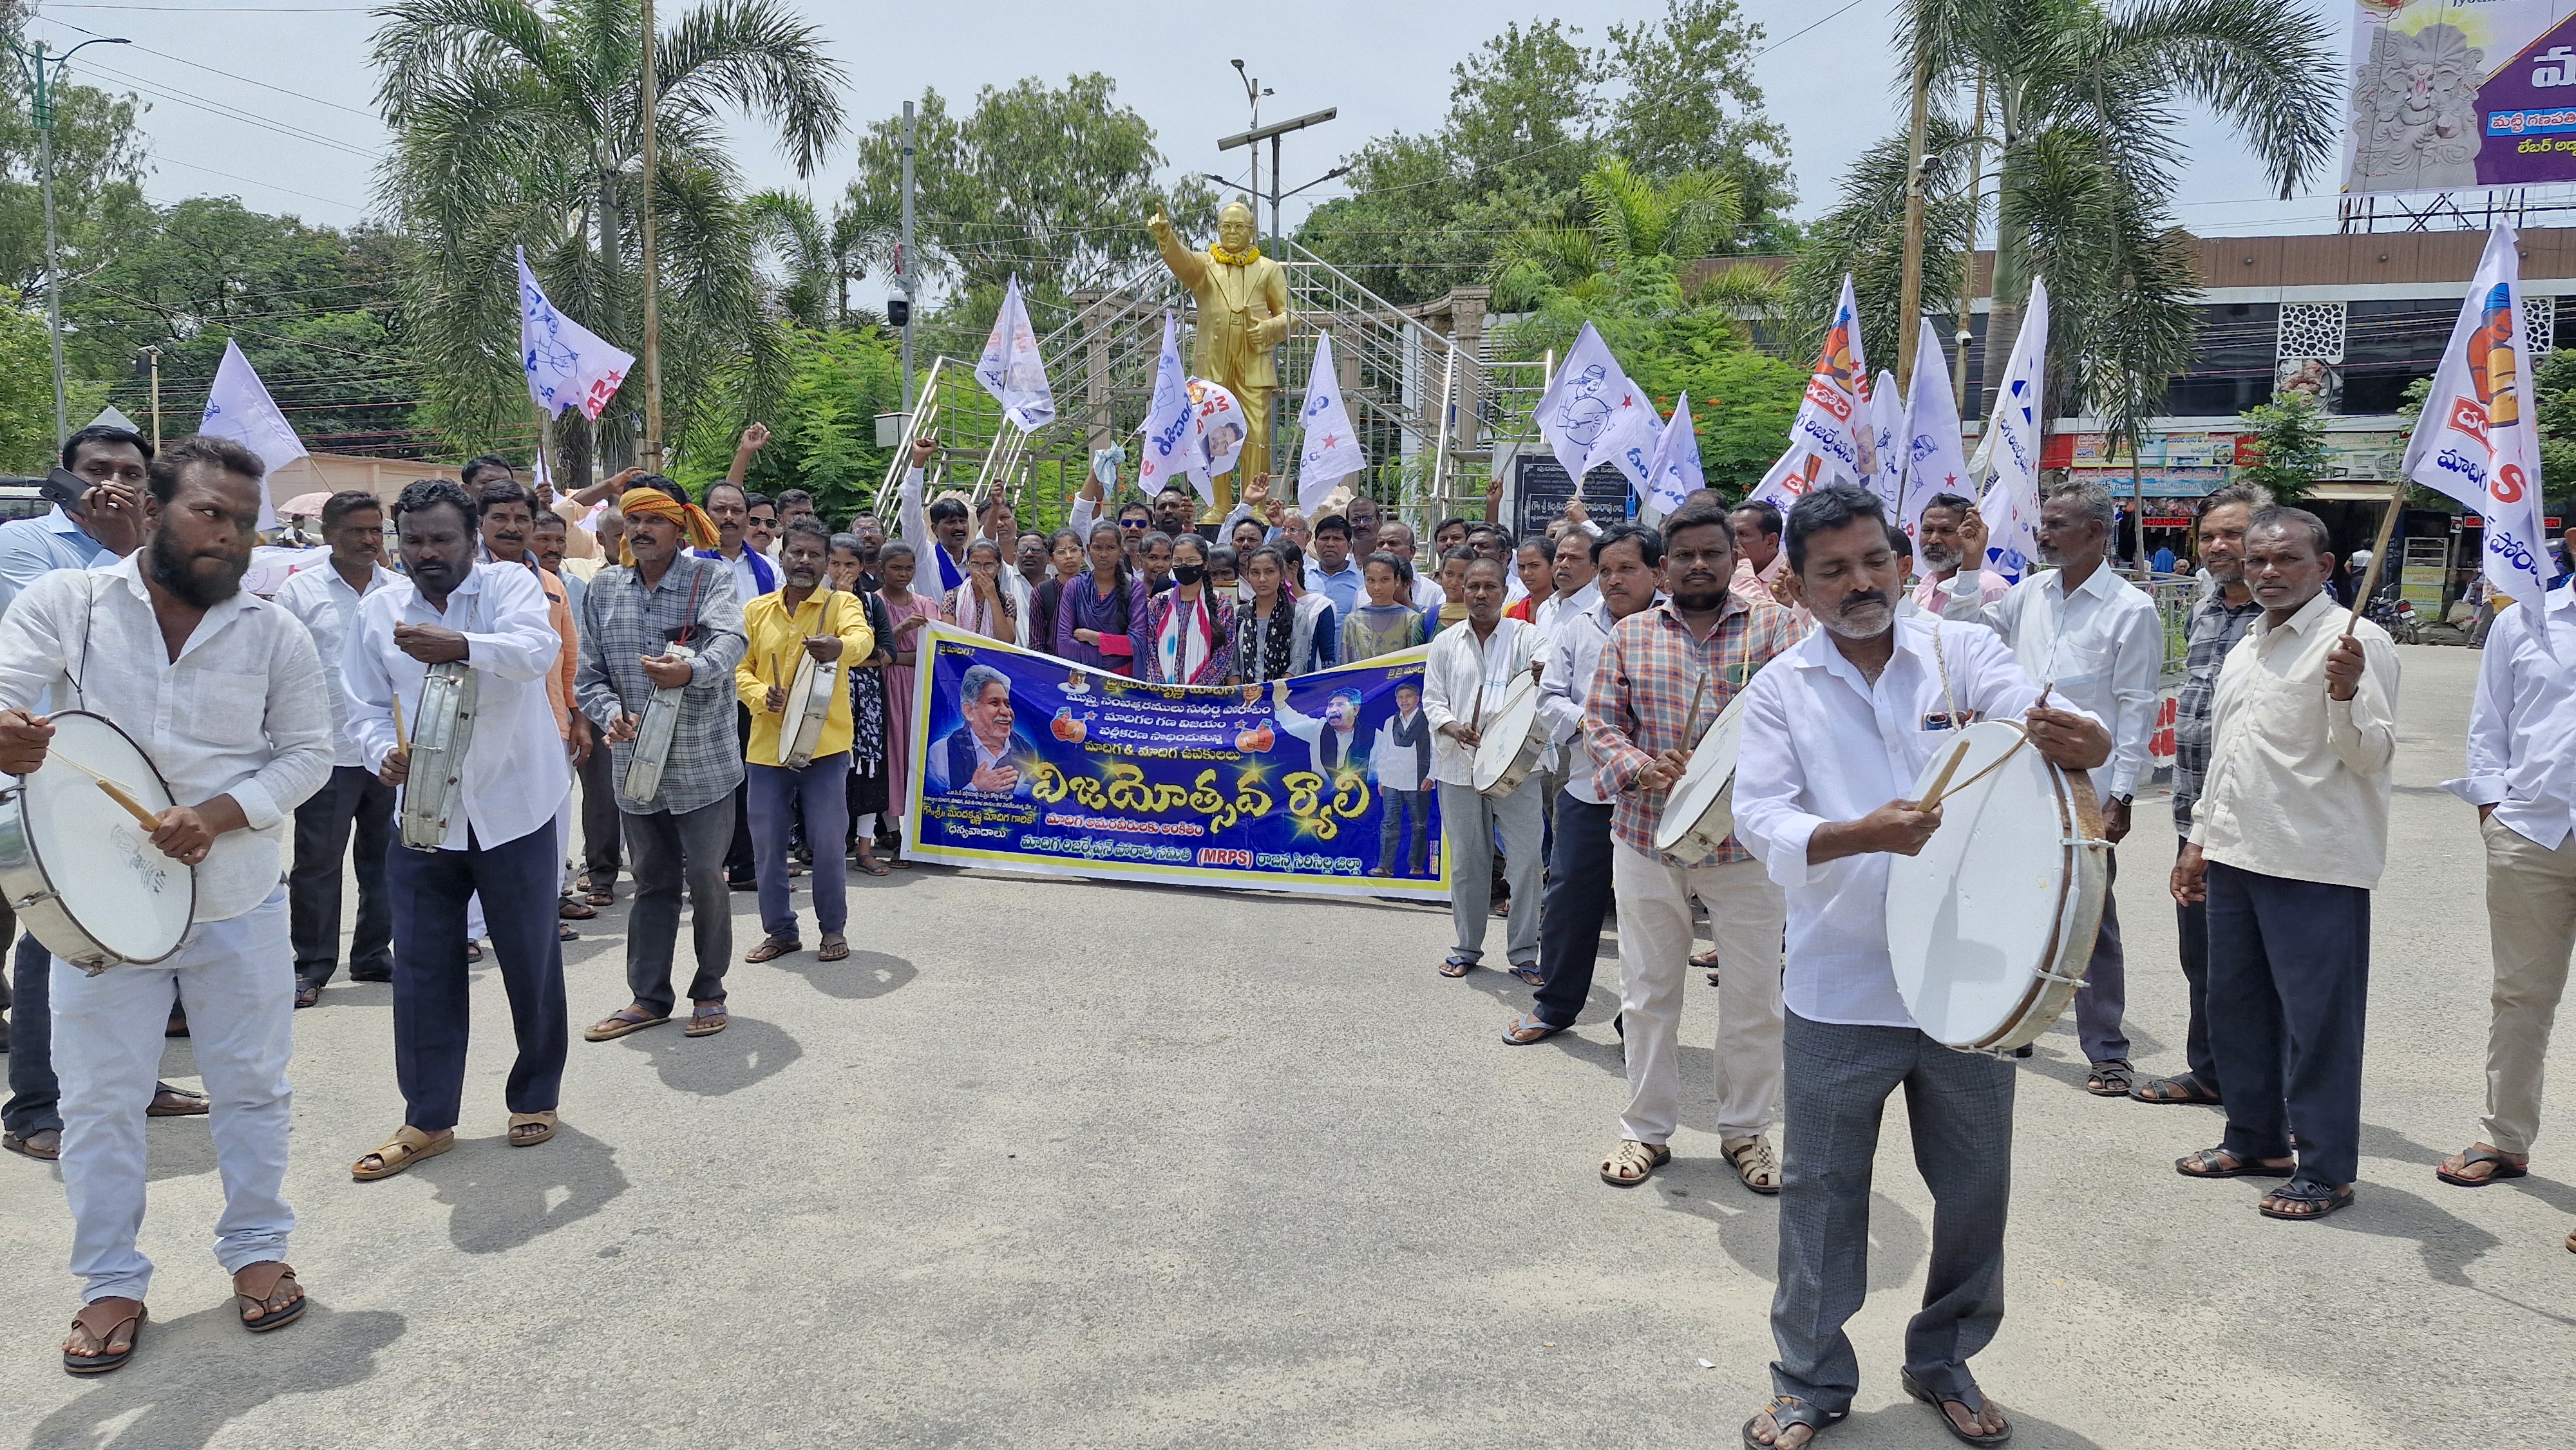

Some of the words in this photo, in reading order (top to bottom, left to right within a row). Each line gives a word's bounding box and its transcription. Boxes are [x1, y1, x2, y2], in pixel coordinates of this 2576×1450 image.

[2492, 112, 2524, 133] మట్టి
[2517, 138, 2552, 153] లేబర్
[1806, 384, 1850, 417] ండోర
[1104, 712, 1153, 725] మాదిగల
[1179, 719, 1227, 730] విజయం
[1084, 740, 1122, 755] మాదిగ
[1124, 744, 1135, 756] &
[1138, 744, 1178, 760] మాదిగ
[1031, 762, 1273, 835] విజయోత్సవ
[983, 812, 1010, 823] మాదిగ
[1046, 813, 1083, 827] మాదిగ
[1085, 816, 1159, 834] అమరవీరులకు
[1161, 822, 1204, 836] అంకితం
[949, 824, 1006, 838] ధన్యవాదాలు
[1021, 835, 1061, 851] మాదిగ
[1062, 836, 1113, 860] రిజర్వేషన్
[1115, 843, 1154, 859] పోరాట
[1156, 844, 1191, 861] సమితి
[1197, 847, 1253, 869] (MRPS)
[1256, 852, 1294, 872] రాజన్న
[1334, 856, 1362, 876] జిల్లా
